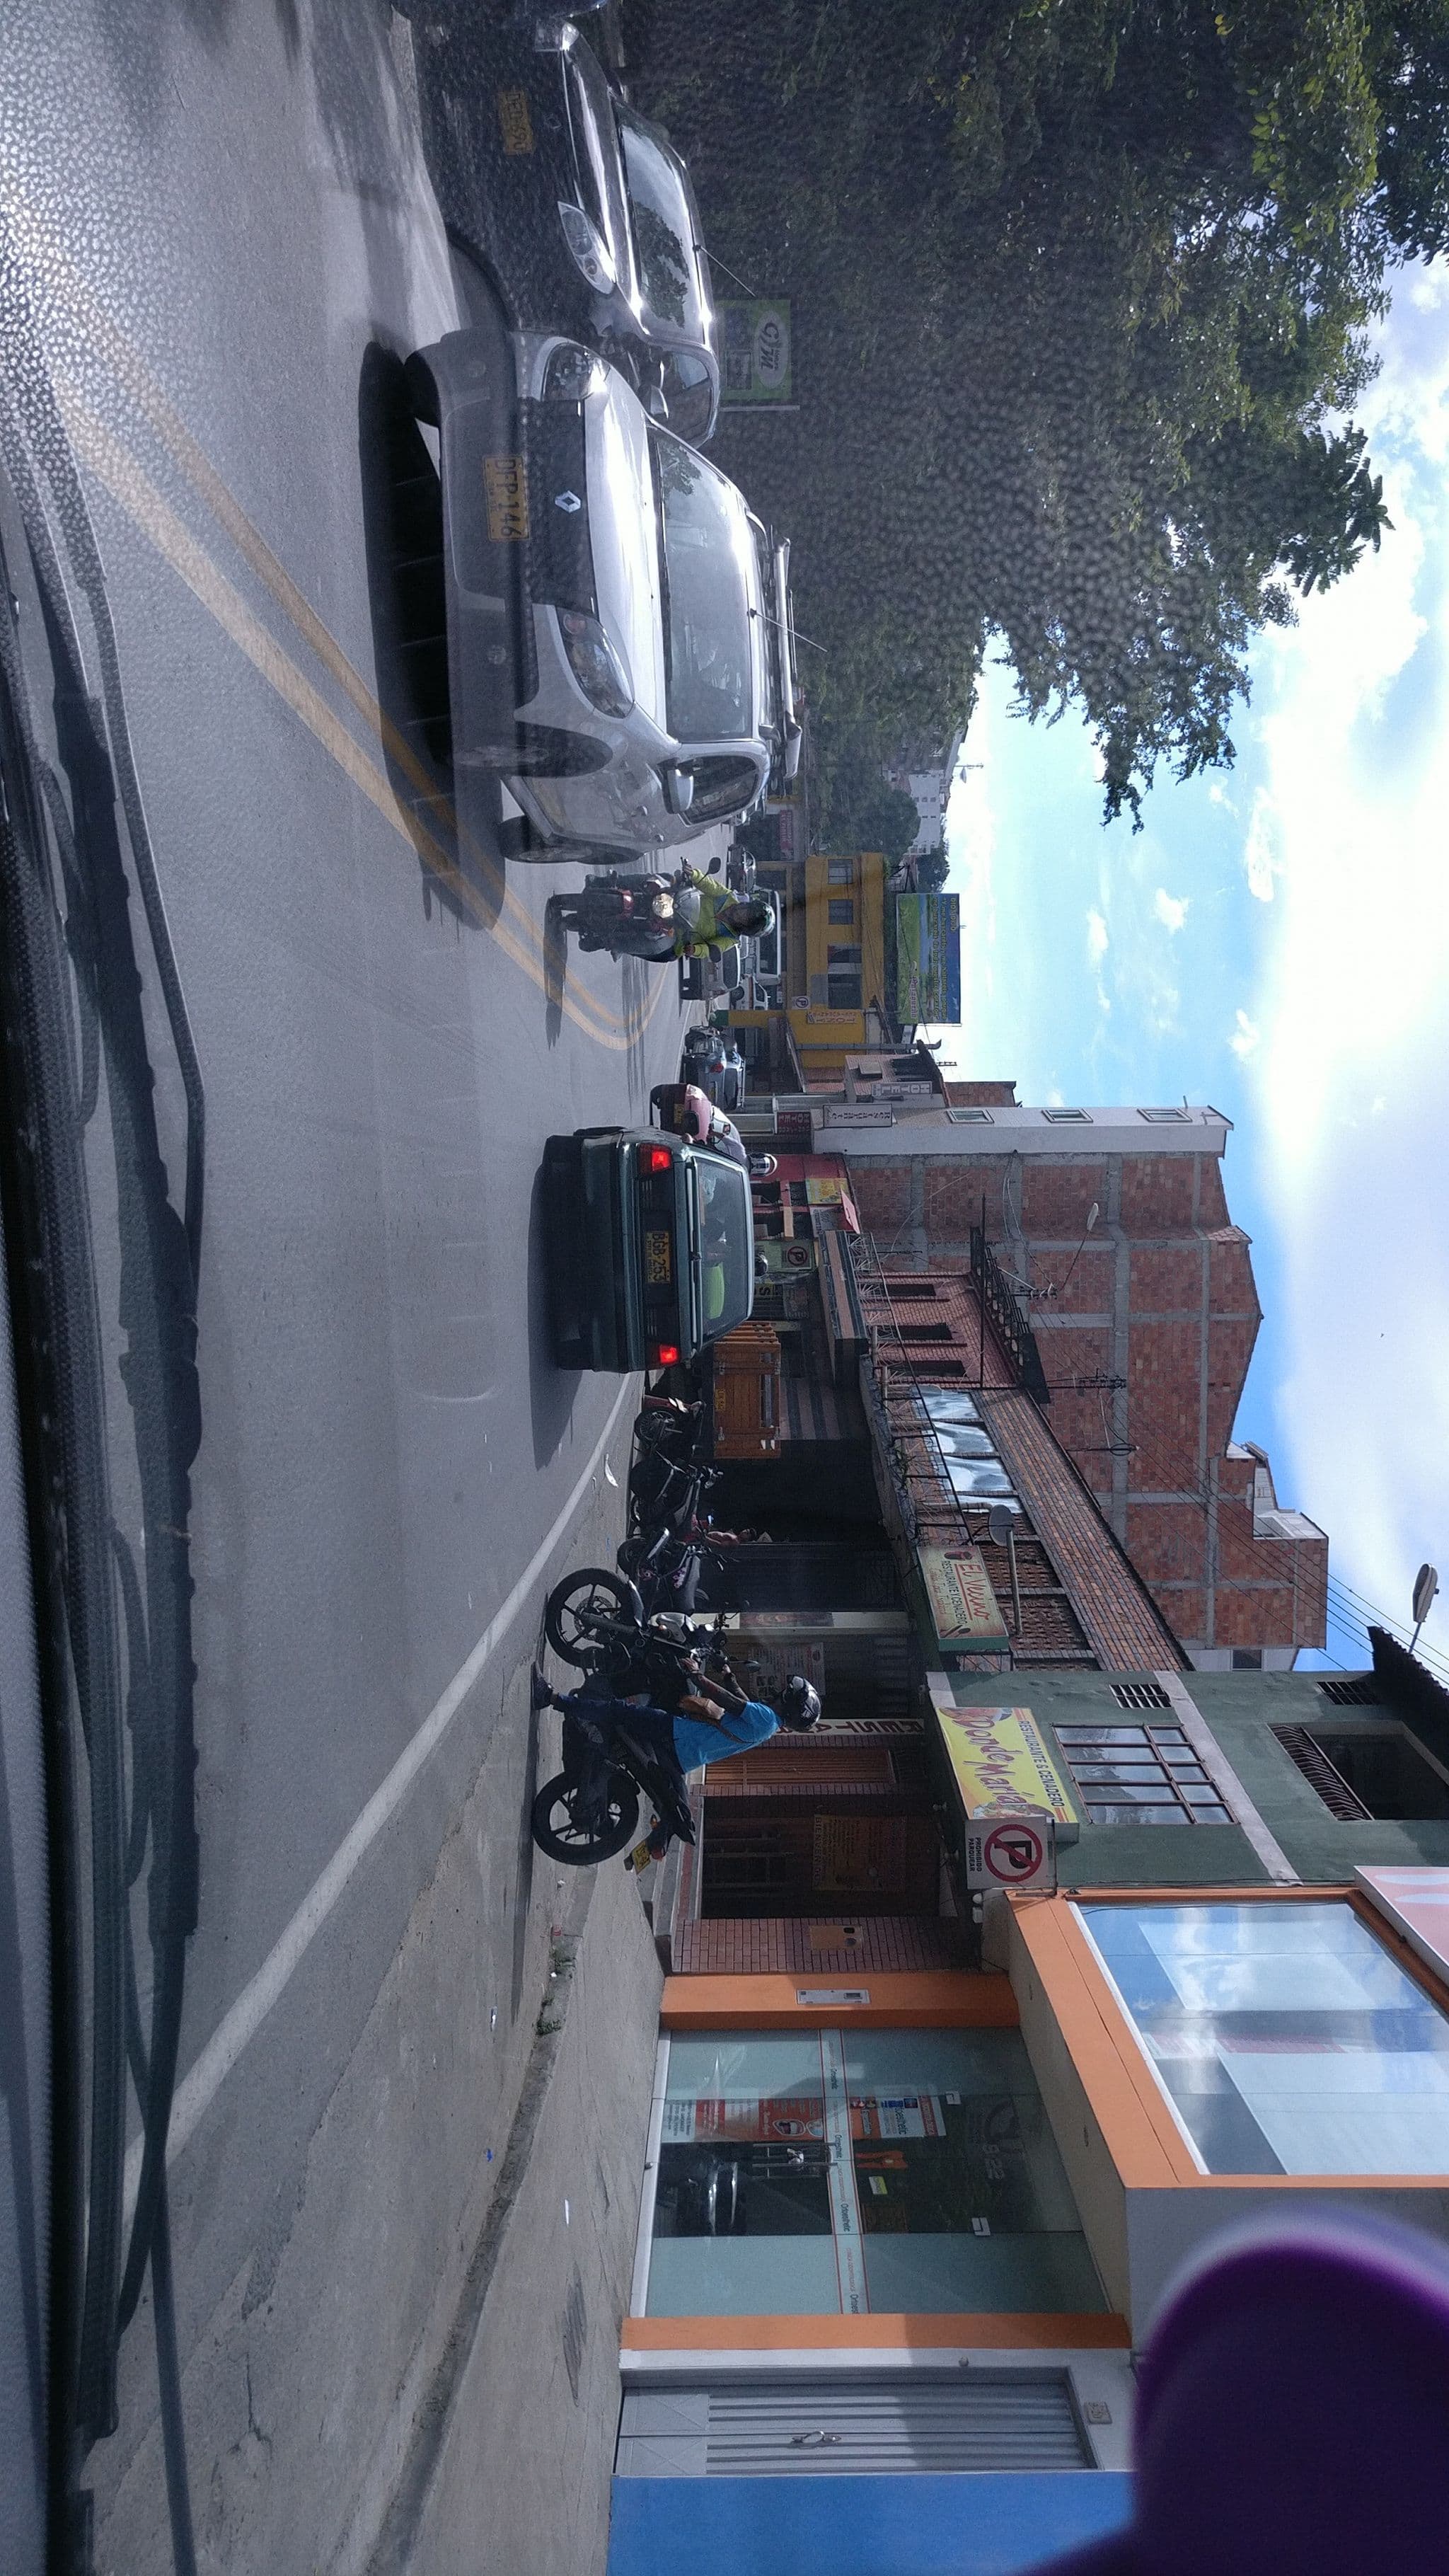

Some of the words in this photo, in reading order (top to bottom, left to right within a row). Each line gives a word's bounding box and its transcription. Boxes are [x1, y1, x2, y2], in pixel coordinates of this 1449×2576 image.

[882, 1083, 930, 1093] HOTEL
[941, 1560, 959, 1592] RESTAURANTE
[950, 1597, 968, 1624] CENADERO
[964, 1579, 992, 1620] Vecino
[952, 1718, 1024, 1763] Donde
[963, 1761, 1036, 1805] María
[1017, 1720, 1046, 1763] RESTAURANTE
[1039, 1770, 1066, 1807] CENADERO
[814, 1817, 822, 1887] BIENVENDOS
